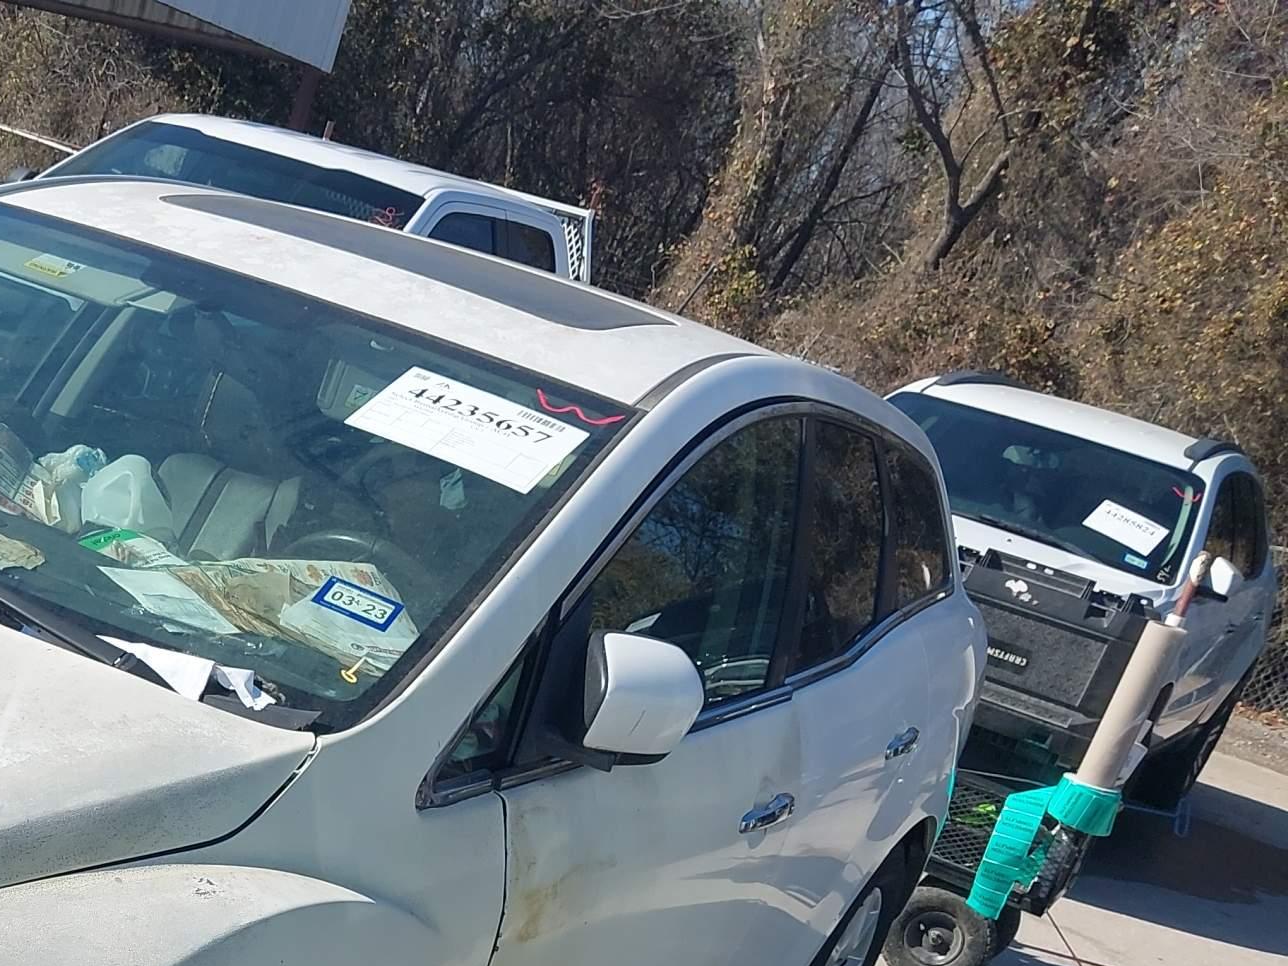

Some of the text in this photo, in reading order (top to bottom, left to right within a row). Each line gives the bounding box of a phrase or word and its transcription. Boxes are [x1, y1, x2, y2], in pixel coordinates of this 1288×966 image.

[407, 387, 553, 444] 44235657
[331, 591, 388, 620] 03 23
